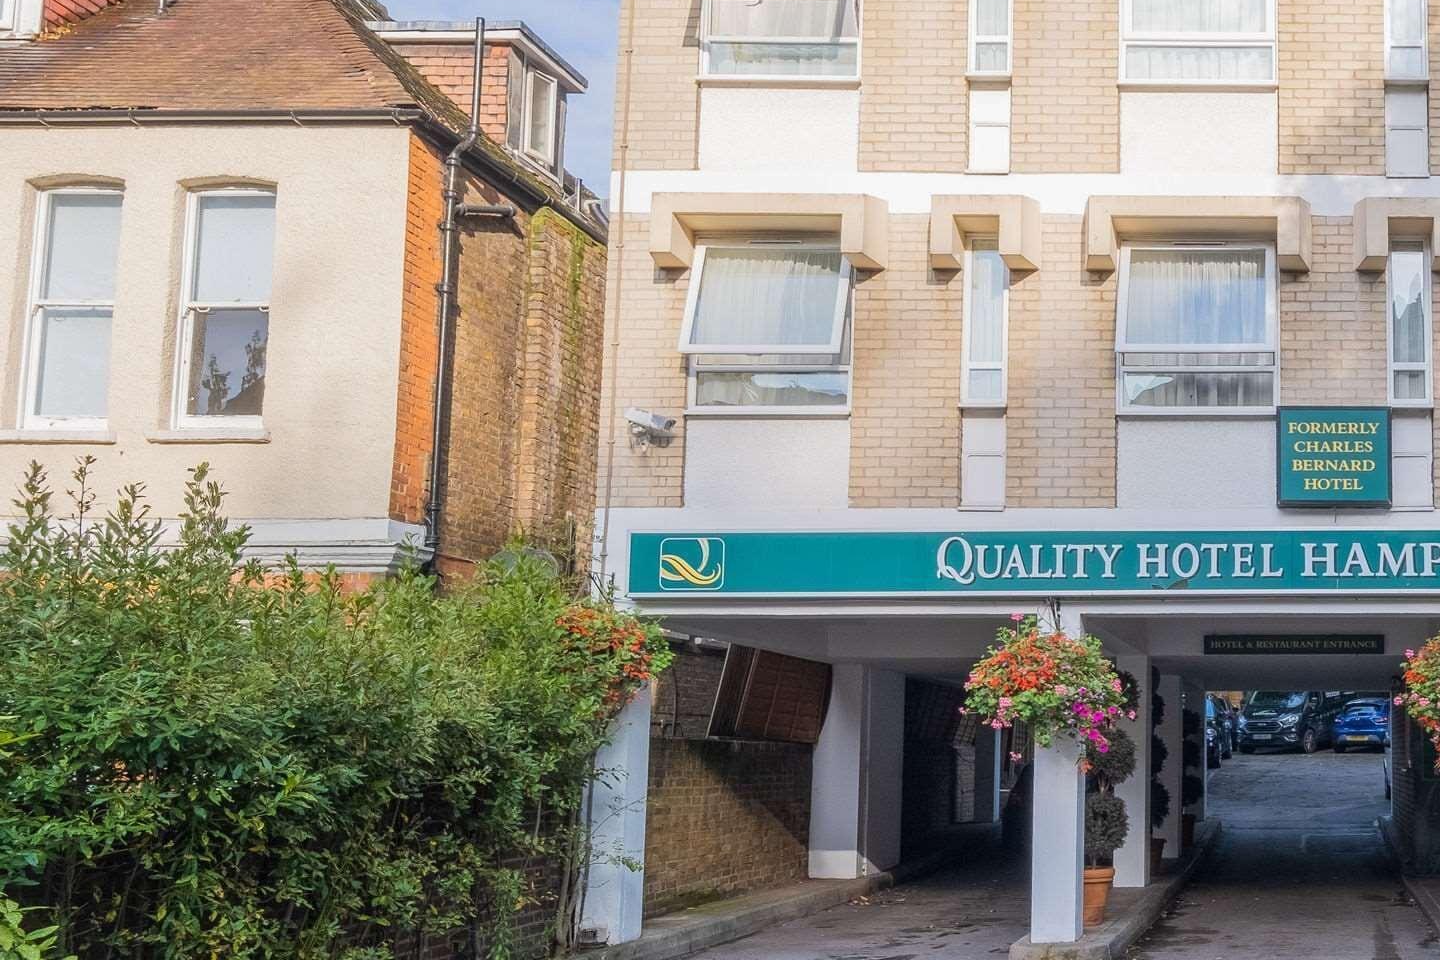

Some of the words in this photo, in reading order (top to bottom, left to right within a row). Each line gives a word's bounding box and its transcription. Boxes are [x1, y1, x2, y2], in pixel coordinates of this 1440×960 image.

[1288, 422, 1380, 434] FORMERLY
[1293, 441, 1373, 453] CHARLES
[1292, 459, 1376, 472] BERNARD
[1303, 478, 1363, 490] HOTEL
[936, 536, 1123, 585] QUALITY
[1136, 543, 1284, 579] HOTEL
[1210, 640, 1244, 649] HOTEL
[1256, 640, 1320, 649] RESTAURANT
[1323, 640, 1377, 649] ENTRANCE
